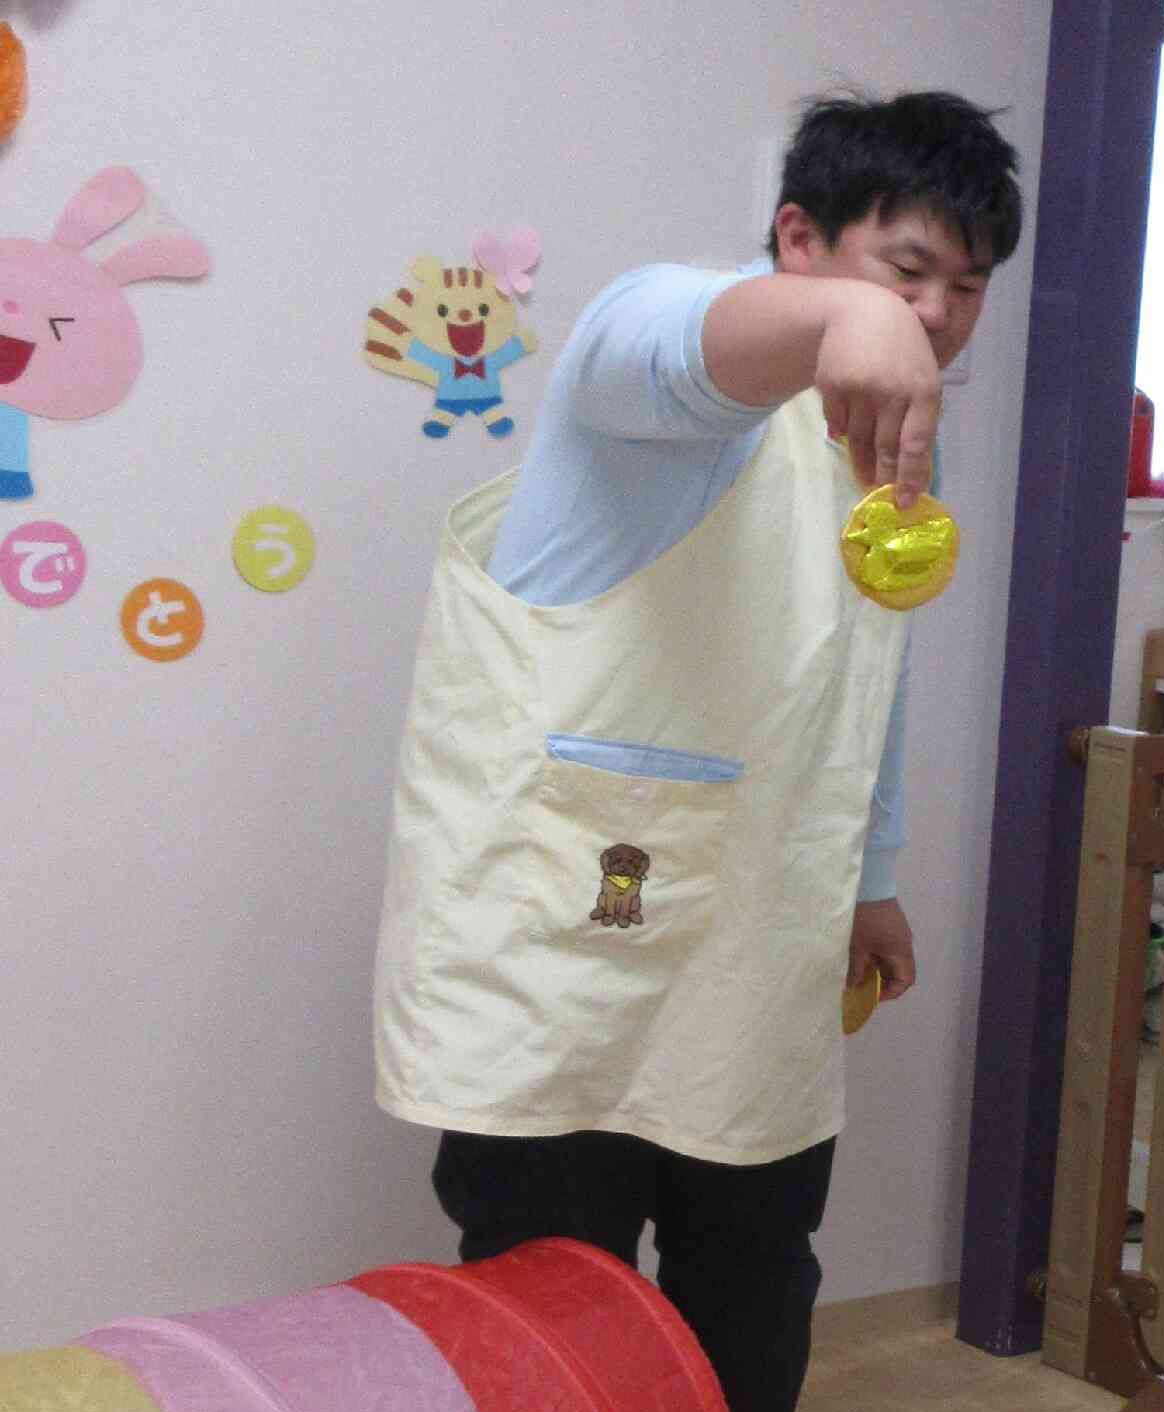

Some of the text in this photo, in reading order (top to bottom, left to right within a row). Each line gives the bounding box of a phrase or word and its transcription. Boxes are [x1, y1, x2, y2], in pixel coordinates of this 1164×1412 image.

[12, 523, 297, 646] で と う
